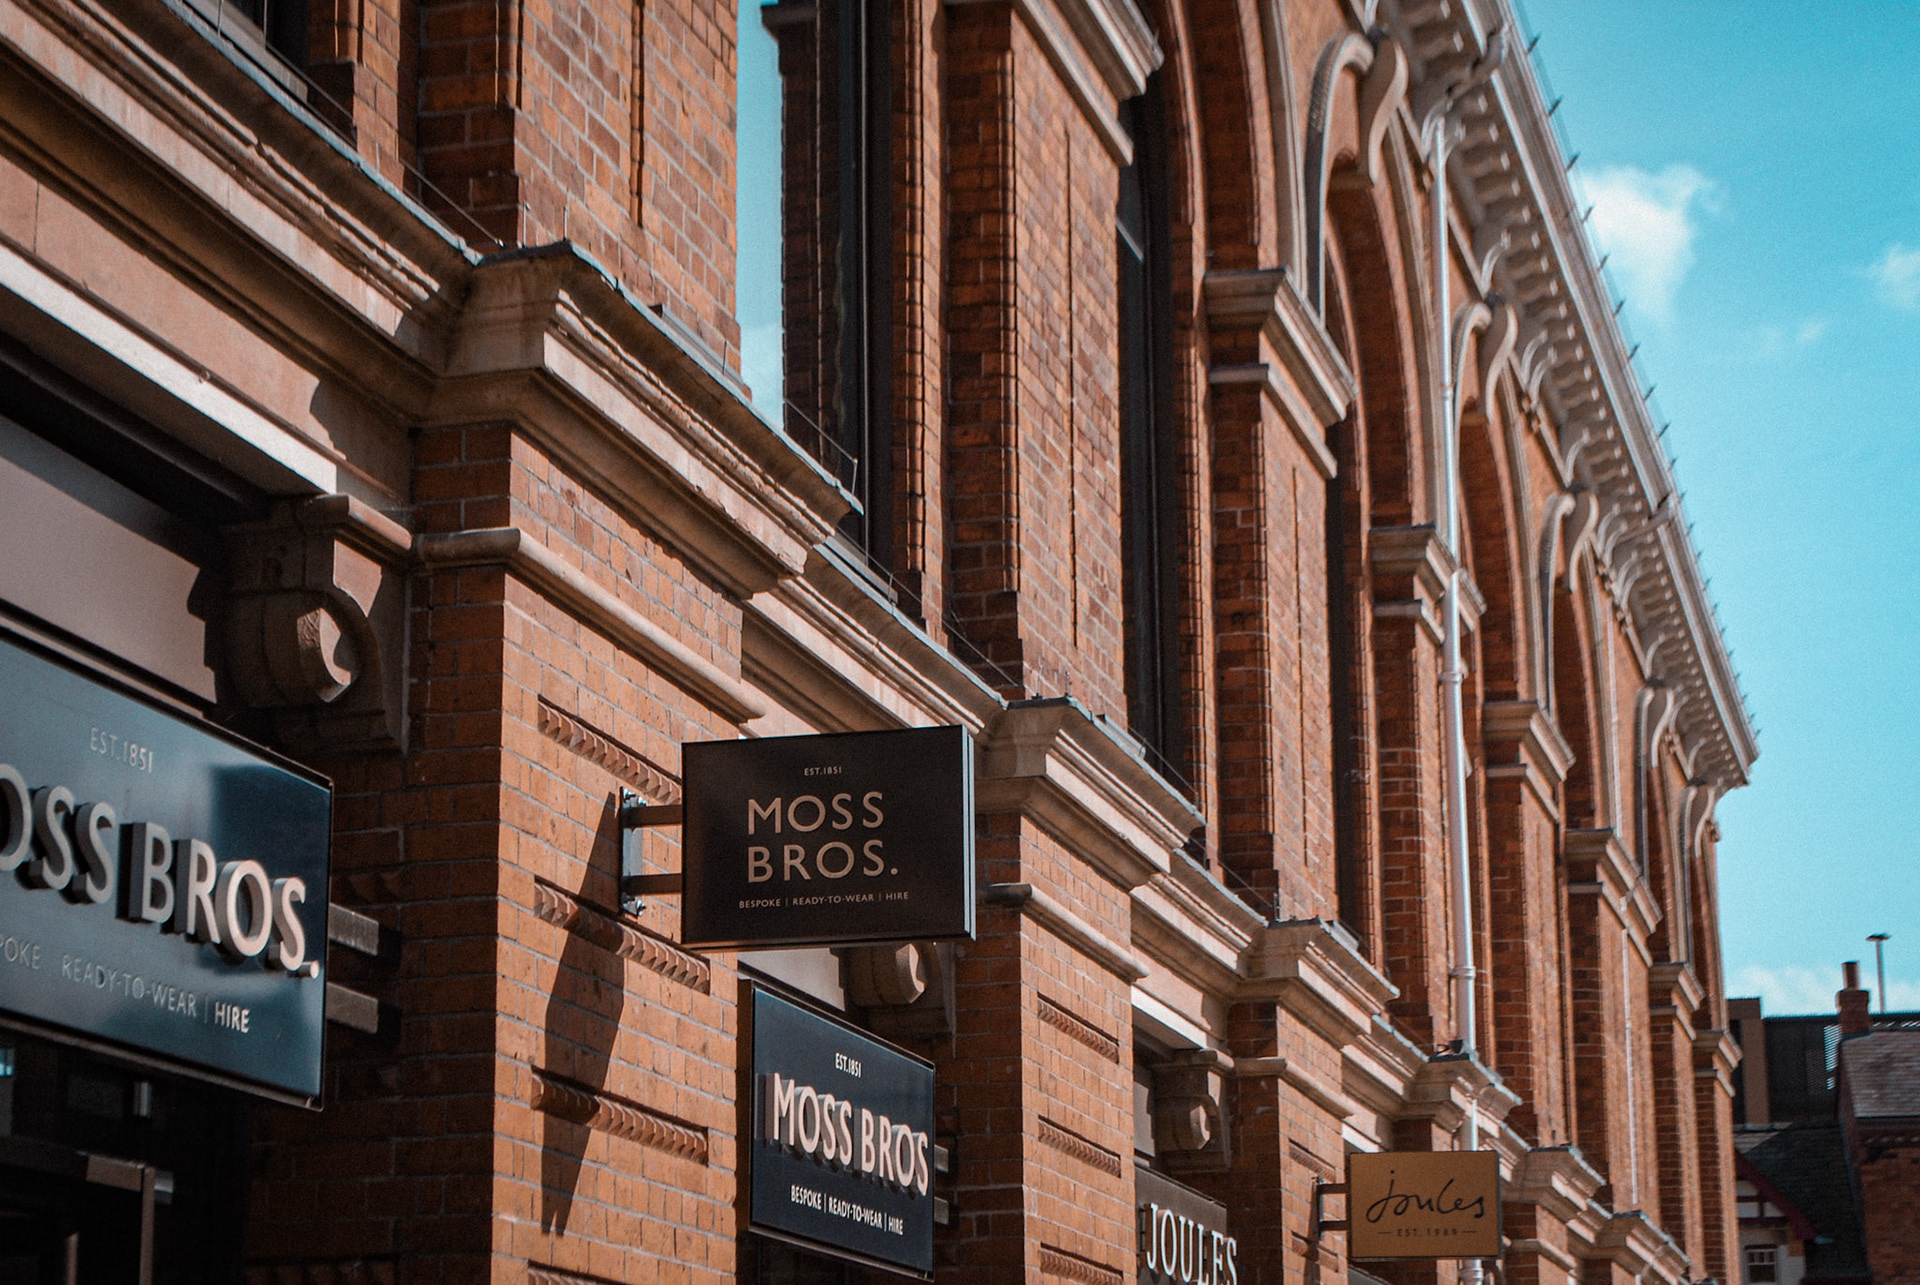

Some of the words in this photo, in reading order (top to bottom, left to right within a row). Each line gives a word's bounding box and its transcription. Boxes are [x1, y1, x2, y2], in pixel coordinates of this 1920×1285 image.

[90, 727, 154, 774] EST.1851
[803, 766, 843, 776] EST.1851
[747, 790, 885, 836] MOSS
[747, 838, 899, 884] BROS.
[738, 898, 782, 909] BESPOKE
[792, 893, 875, 906] READY-TO-WEAR
[885, 891, 910, 901] HIRE
[0, 934, 41, 970] OKE
[62, 953, 197, 1018] READY-TO-WEAR
[214, 1001, 251, 1034] HIRE
[835, 1052, 863, 1079] EST.1851
[773, 1071, 853, 1167] MOSS
[790, 1184, 823, 1211] BESPOKE
[828, 1197, 883, 1230] READY-TO-WEAR
[888, 1216, 904, 1236] HIRE
[1365, 1168, 1485, 1223] joules
[1145, 1202, 1238, 1285] JOULES
